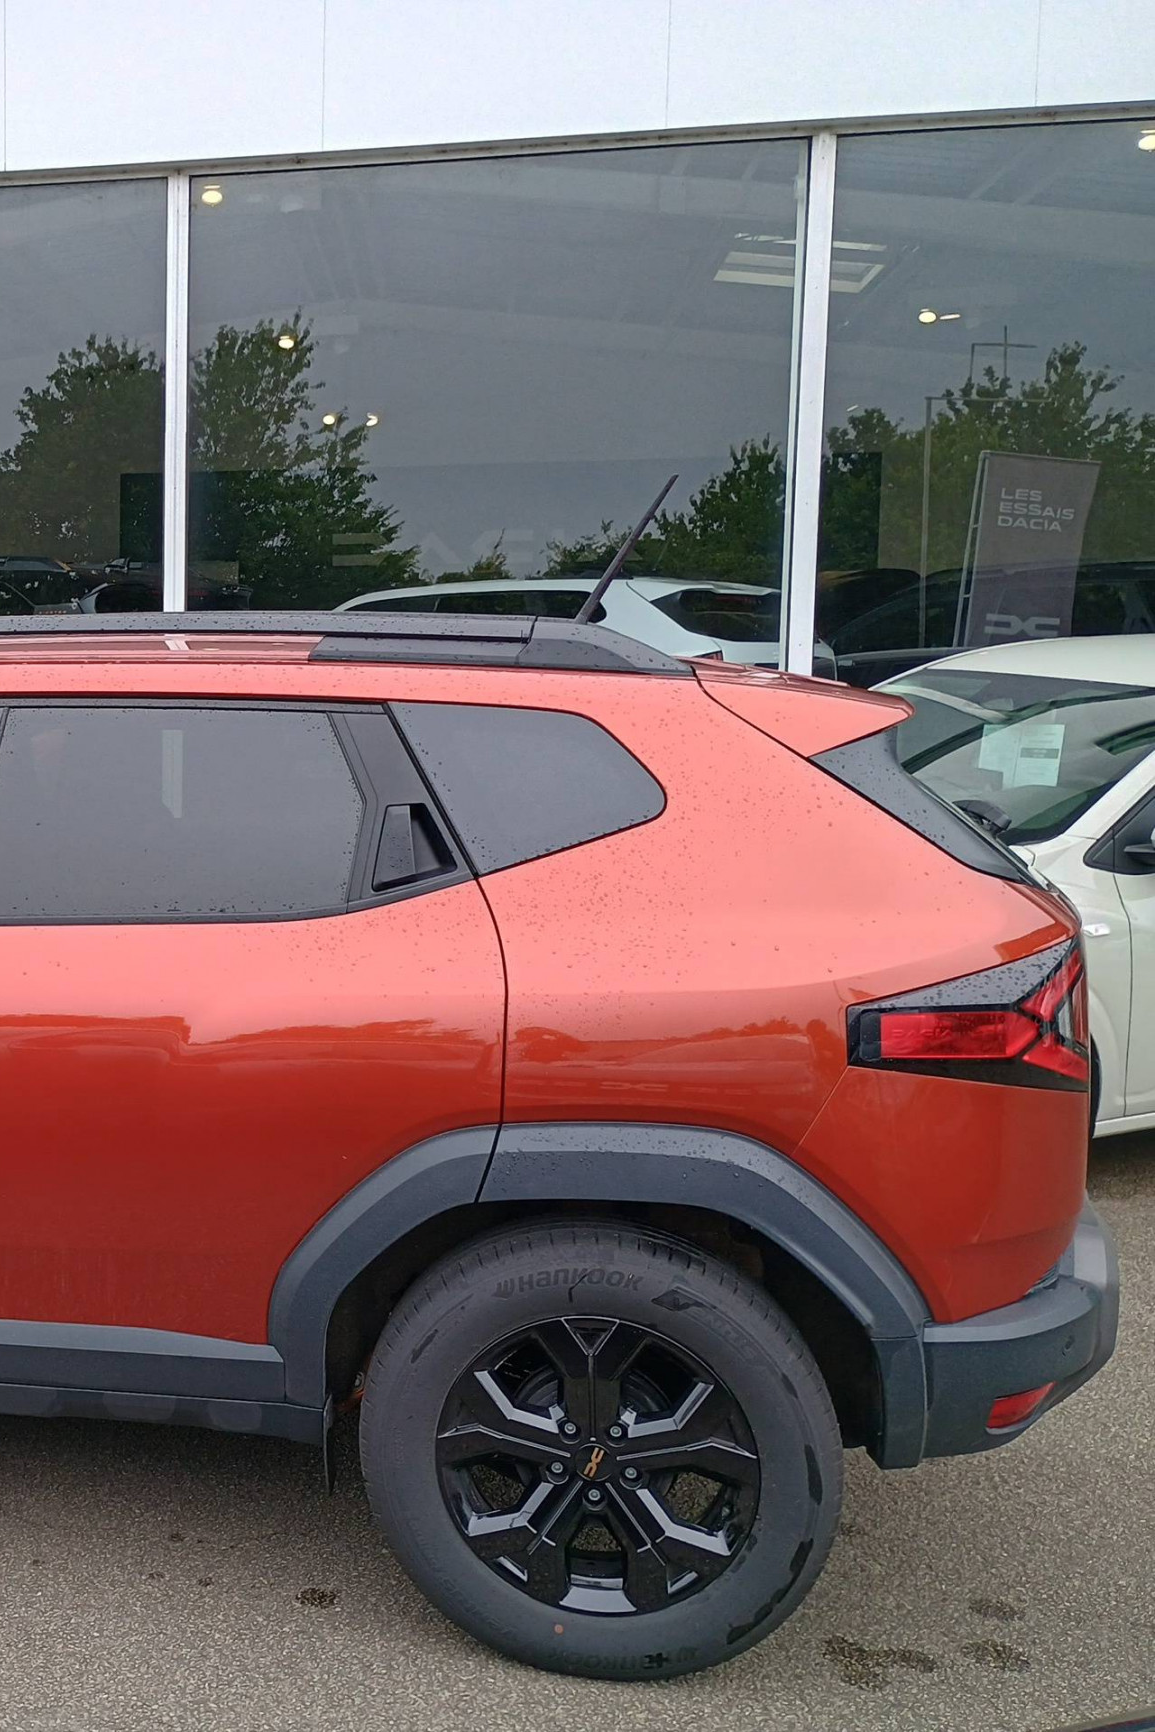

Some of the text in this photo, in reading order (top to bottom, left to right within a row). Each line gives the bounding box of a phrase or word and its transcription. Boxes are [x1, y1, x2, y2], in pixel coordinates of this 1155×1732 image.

[1001, 488, 1042, 502] LES
[999, 501, 1075, 520] ESSAIS
[997, 515, 1062, 532] DACIA
